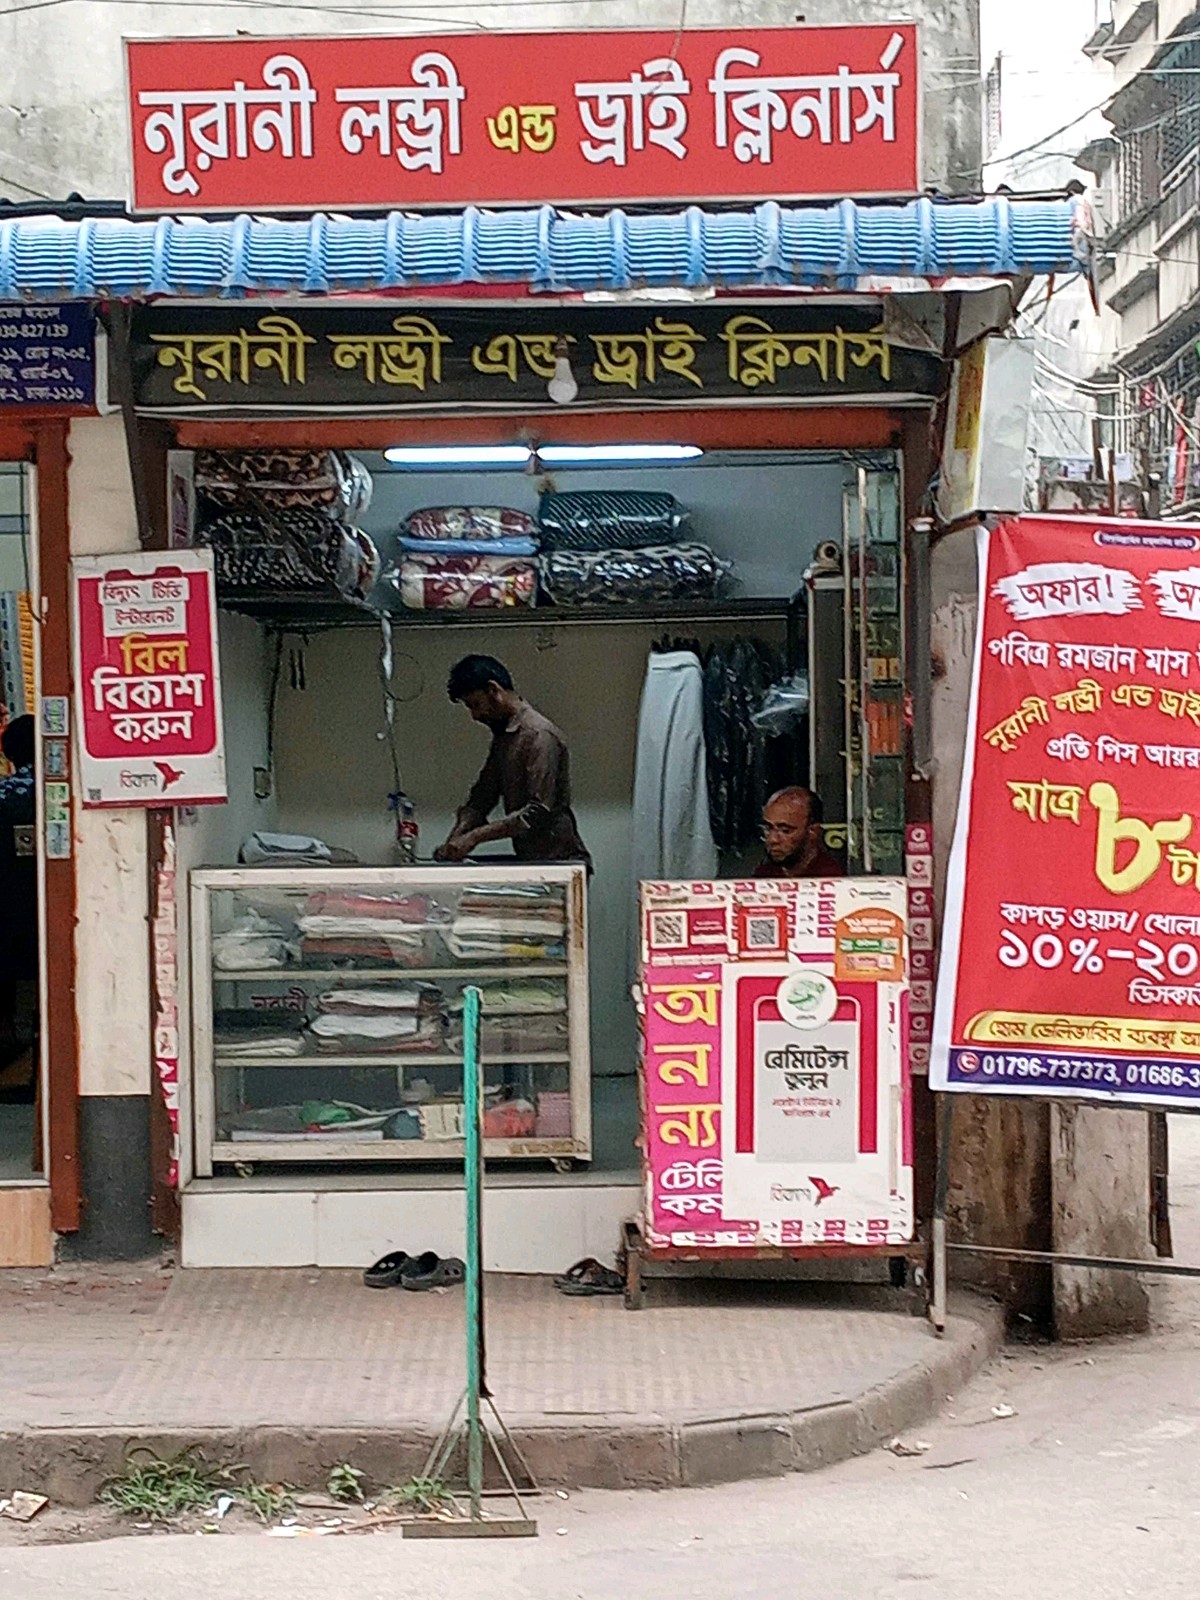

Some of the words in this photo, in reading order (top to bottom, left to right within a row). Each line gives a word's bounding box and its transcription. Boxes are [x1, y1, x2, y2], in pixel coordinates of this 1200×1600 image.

[139, 54, 316, 195] নূরানী
[335, 51, 464, 173] লন্ড্রী
[486, 105, 556, 152] এন্ড
[574, 58, 690, 165] ড্রাই
[708, 33, 904, 163] ক্লিনার্স
[150, 316, 317, 400] নূরানী
[326, 316, 453, 390] লন্ড্রী
[588, 316, 707, 389] ড্রাই
[1017, 574, 1114, 609] অফার!
[120, 632, 190, 675] বিল
[988, 631, 1051, 668] পবিত্র
[1055, 642, 1139, 675] রমজান
[1142, 646, 1192, 678] মাস
[91, 666, 206, 711] বিকাশ
[110, 711, 194, 743] করুন
[1046, 733, 1093, 760] প্রতি
[1095, 735, 1140, 765] পিস
[1006, 778, 1086, 826] মাত্র
[1089, 782, 1193, 895] ৮
[1000, 903, 1067, 930] কাপড়
